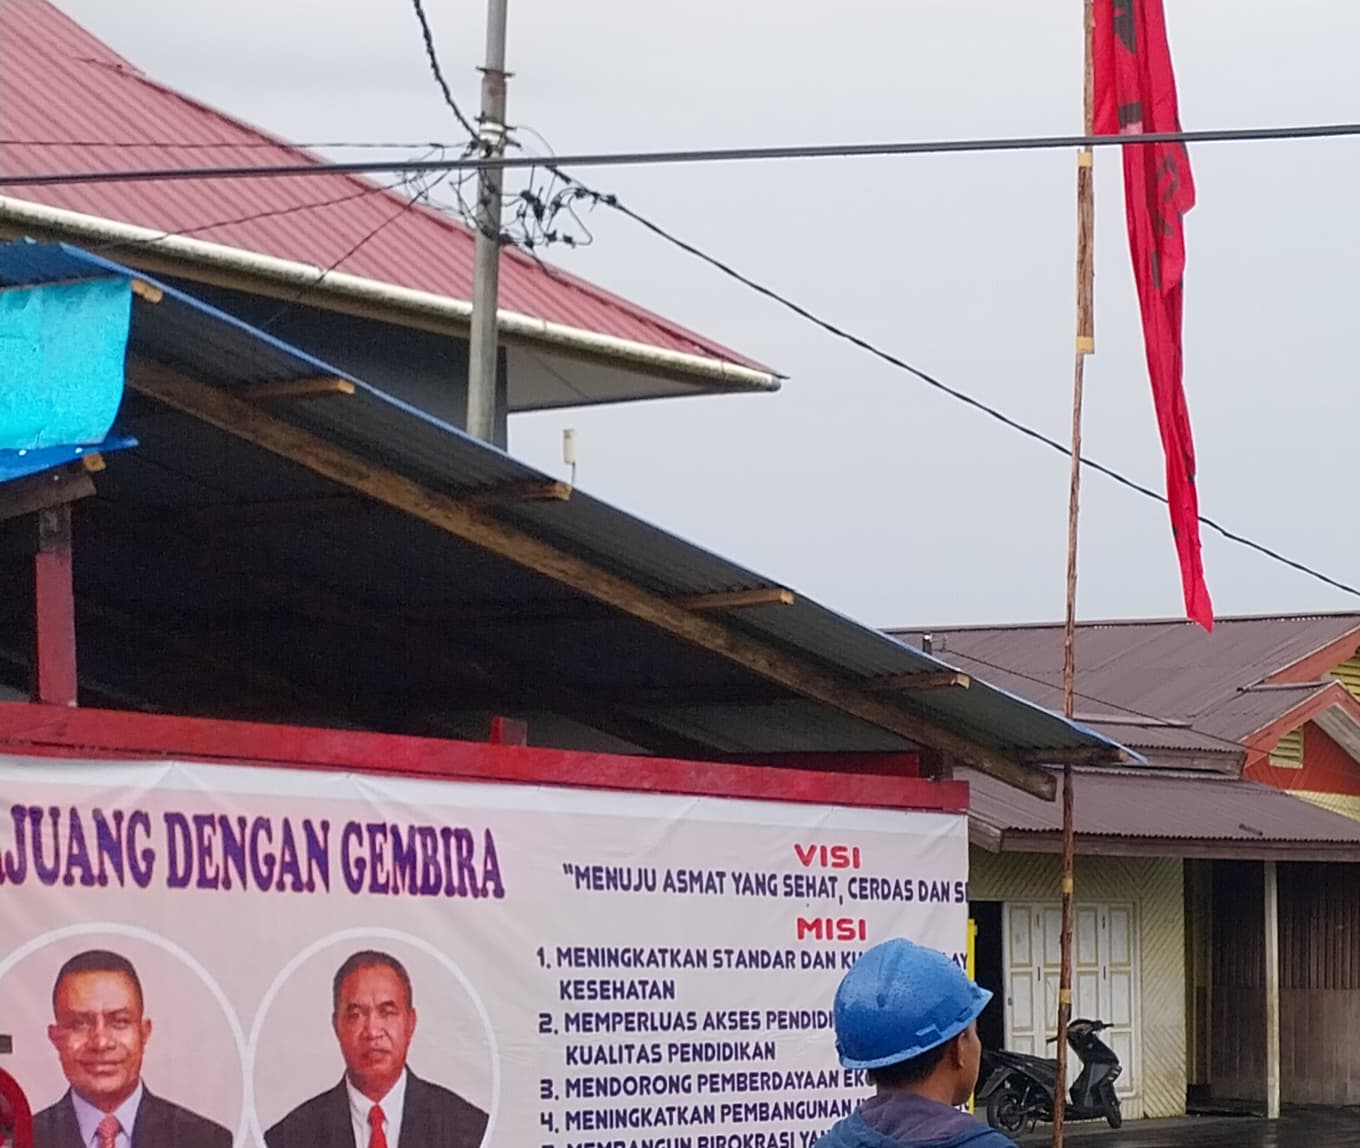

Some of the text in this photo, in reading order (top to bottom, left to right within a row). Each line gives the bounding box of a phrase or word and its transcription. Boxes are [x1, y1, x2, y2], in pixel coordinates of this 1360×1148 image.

[0, 804, 505, 899] JUANG DENGAN GEMBIRA
[794, 843, 862, 870] VISI
[663, 871, 725, 896] ASMAT
[732, 872, 778, 898] YANG
[783, 874, 844, 906] SEHAT,
[847, 877, 914, 902] CERDAS
[918, 880, 950, 903] DAN
[797, 917, 867, 942] MISI
[536, 948, 552, 970] 1.
[556, 947, 707, 970] MENINGKATKAN
[712, 948, 796, 970] STANDAR
[801, 950, 837, 970] DAN
[560, 980, 675, 1001] KESEHATAN
[538, 1013, 559, 1035] 2.
[564, 1011, 698, 1034] MEMPERLUAS
[702, 1010, 761, 1032] AKSES
[565, 1040, 776, 1067] KUALITAS PENDIDIKAN
[539, 1079, 560, 1101] 3.
[565, 1075, 692, 1099] MENDORONG
[697, 1069, 839, 1094] PEMBERDAYAAN
[540, 1113, 560, 1134] 4.
[565, 1105, 715, 1132] MENINGKATKAN
[720, 1099, 852, 1123] PEMBANGUNAN
